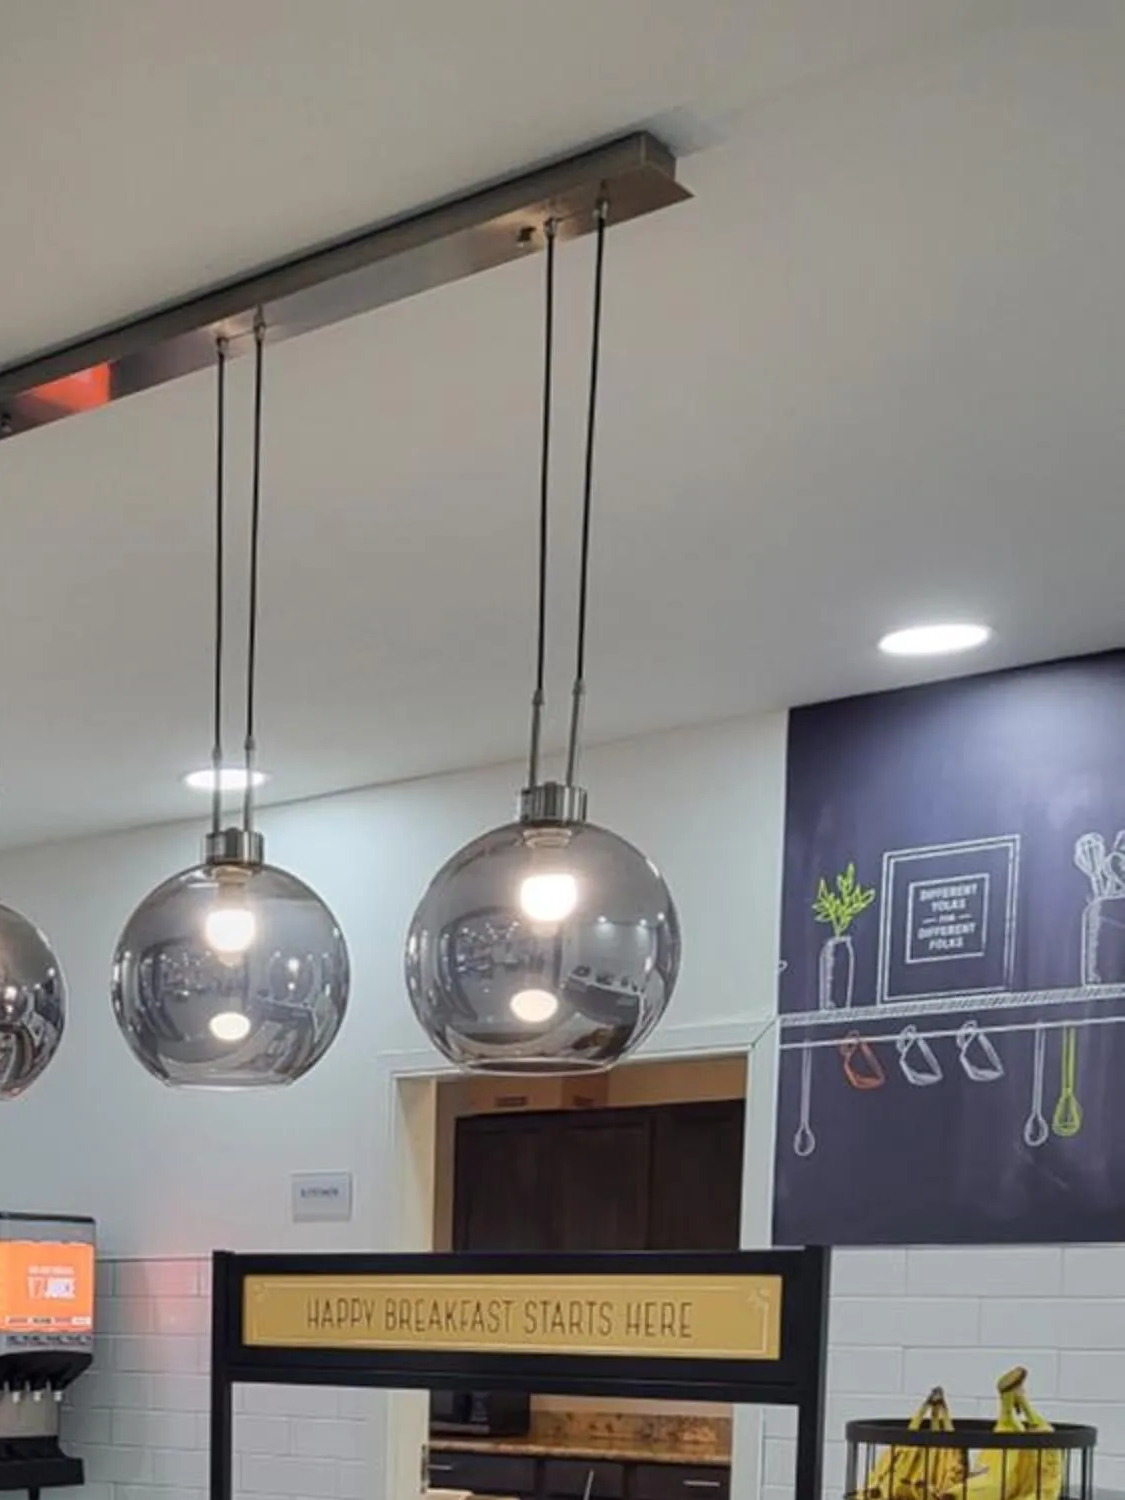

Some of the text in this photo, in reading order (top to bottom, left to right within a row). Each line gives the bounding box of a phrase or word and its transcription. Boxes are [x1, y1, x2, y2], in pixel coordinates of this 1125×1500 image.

[919, 882, 978, 902] DIFFERENT
[917, 921, 976, 940] DIFFERENT
[306, 1296, 694, 1339] HAPPY BREAKFAST STARTS HERE
